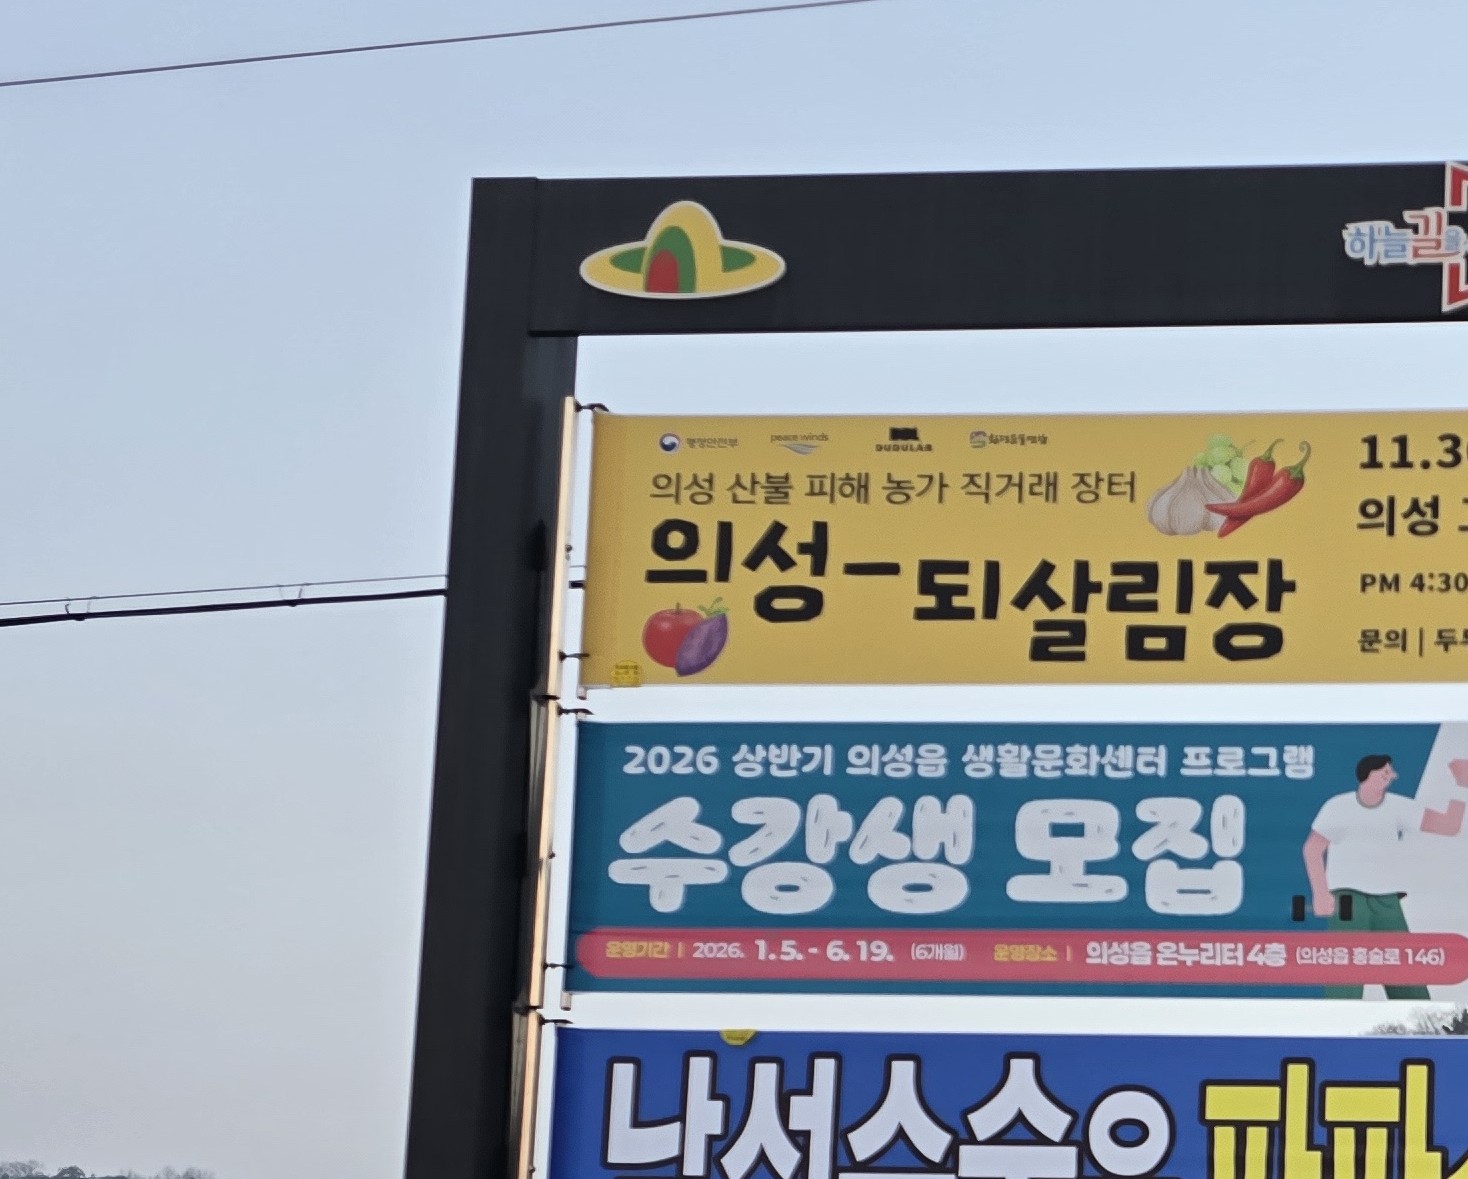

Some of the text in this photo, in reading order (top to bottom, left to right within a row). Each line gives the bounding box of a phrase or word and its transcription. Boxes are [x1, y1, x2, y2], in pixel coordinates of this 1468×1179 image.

[875, 443, 933, 452] DUDULAB
[650, 470, 1137, 505] 의성 산불 피해 농가 직거래 장터
[1357, 494, 1441, 537] 의성
[1359, 572, 1400, 593] PM
[1358, 627, 1408, 654] 문의
[622, 743, 1315, 780] 2026 상반기 의성읍 생활문화센터 프로그램
[608, 793, 1246, 915] 수강생 모집
[605, 941, 668, 958] 운영기간
[692, 942, 744, 959] 2026.
[910, 942, 967, 962] (6개월)
[993, 942, 1057, 961] 운영장소
[1085, 942, 1152, 966] 의성읍
[1156, 942, 1244, 967] 온누리터
[1246, 942, 1287, 967] 4층
[1295, 945, 1350, 967] (의성읍
[1405, 946, 1446, 967] 146)
